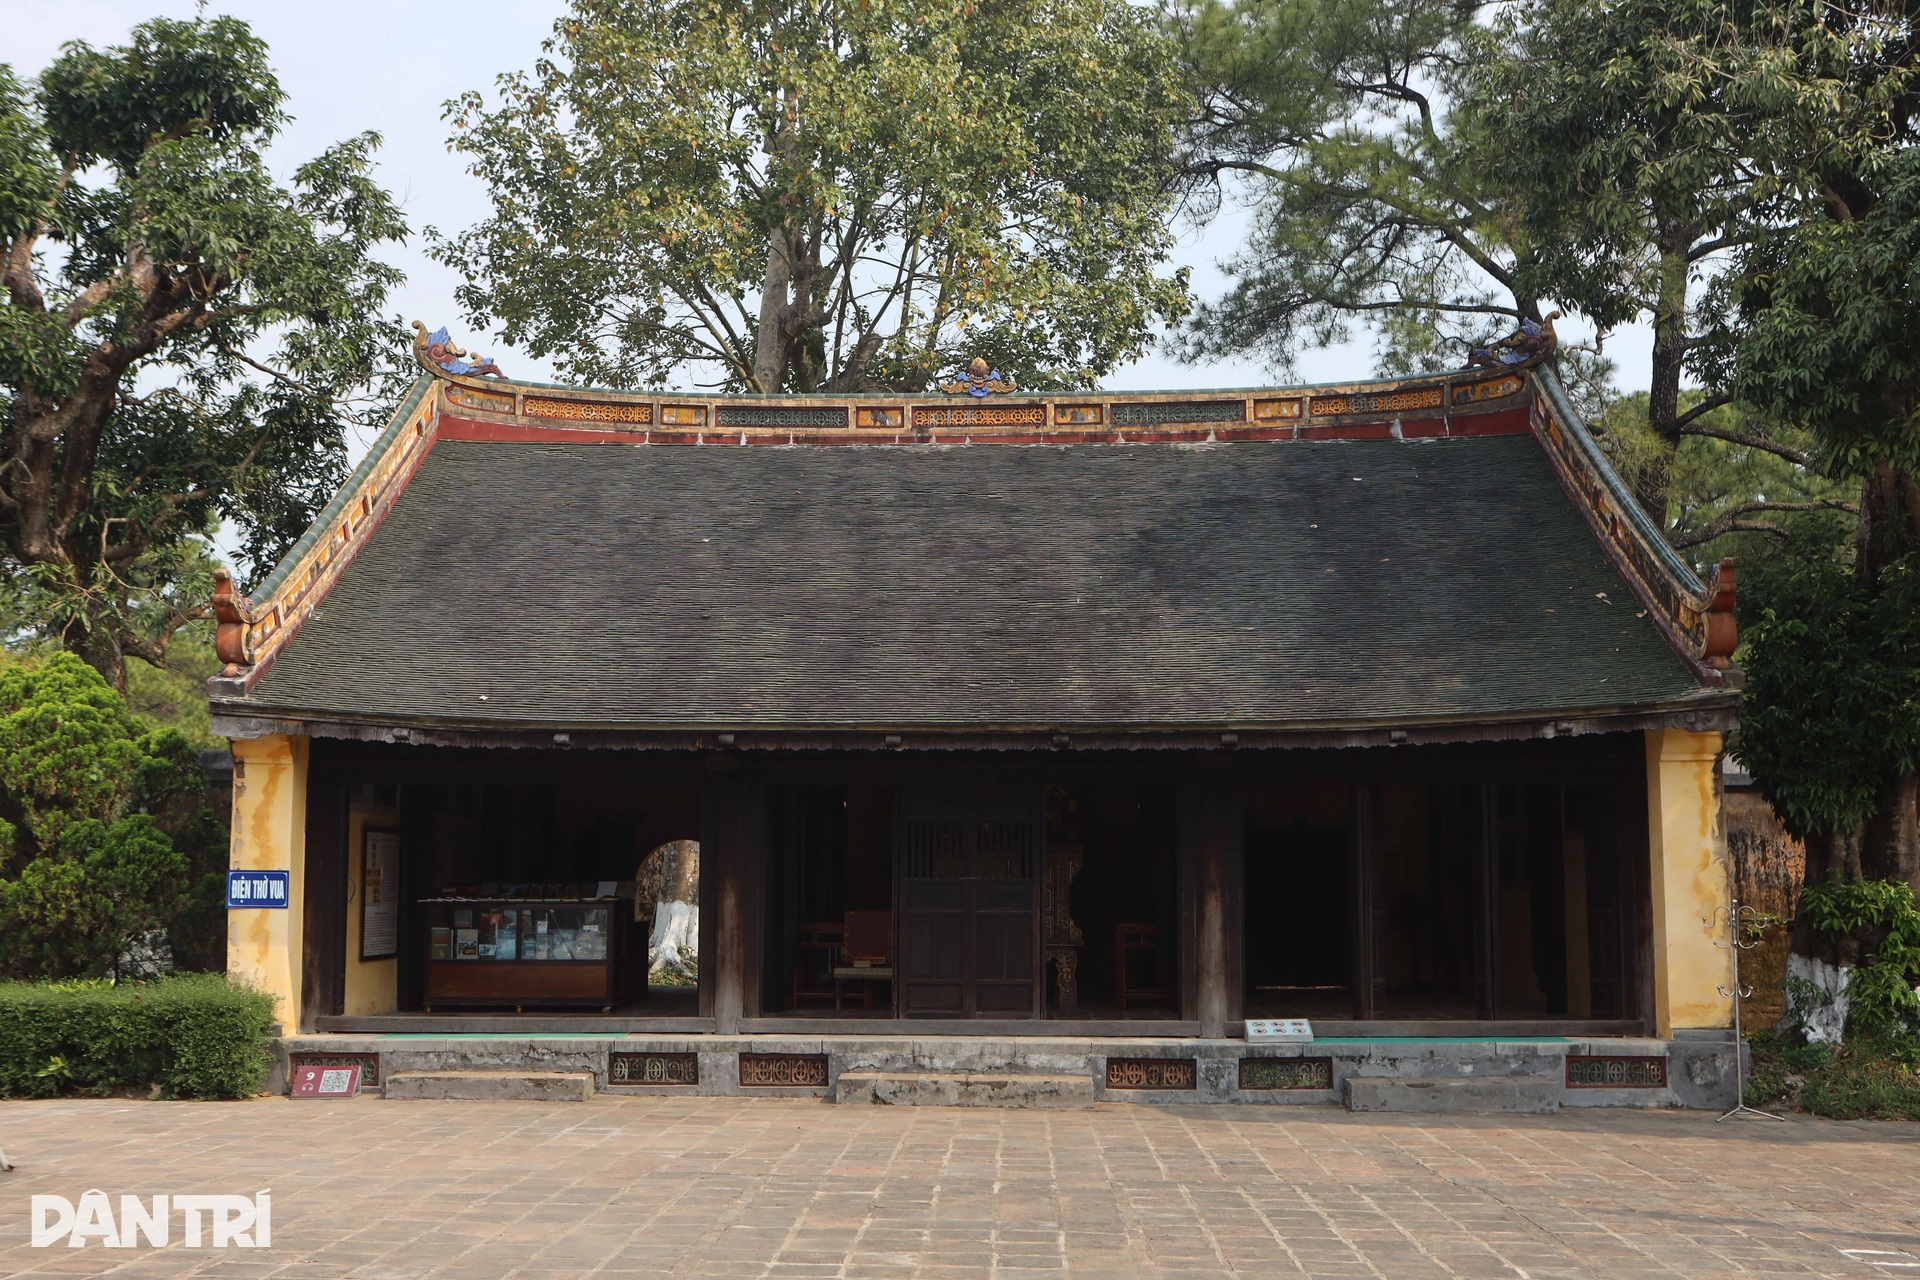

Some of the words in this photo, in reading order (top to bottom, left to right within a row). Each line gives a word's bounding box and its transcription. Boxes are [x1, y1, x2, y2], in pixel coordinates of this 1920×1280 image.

[231, 875, 251, 903] ĐIỆN
[252, 875, 268, 899] THỜ
[269, 880, 285, 899] VUA
[306, 1072, 315, 1081] 9
